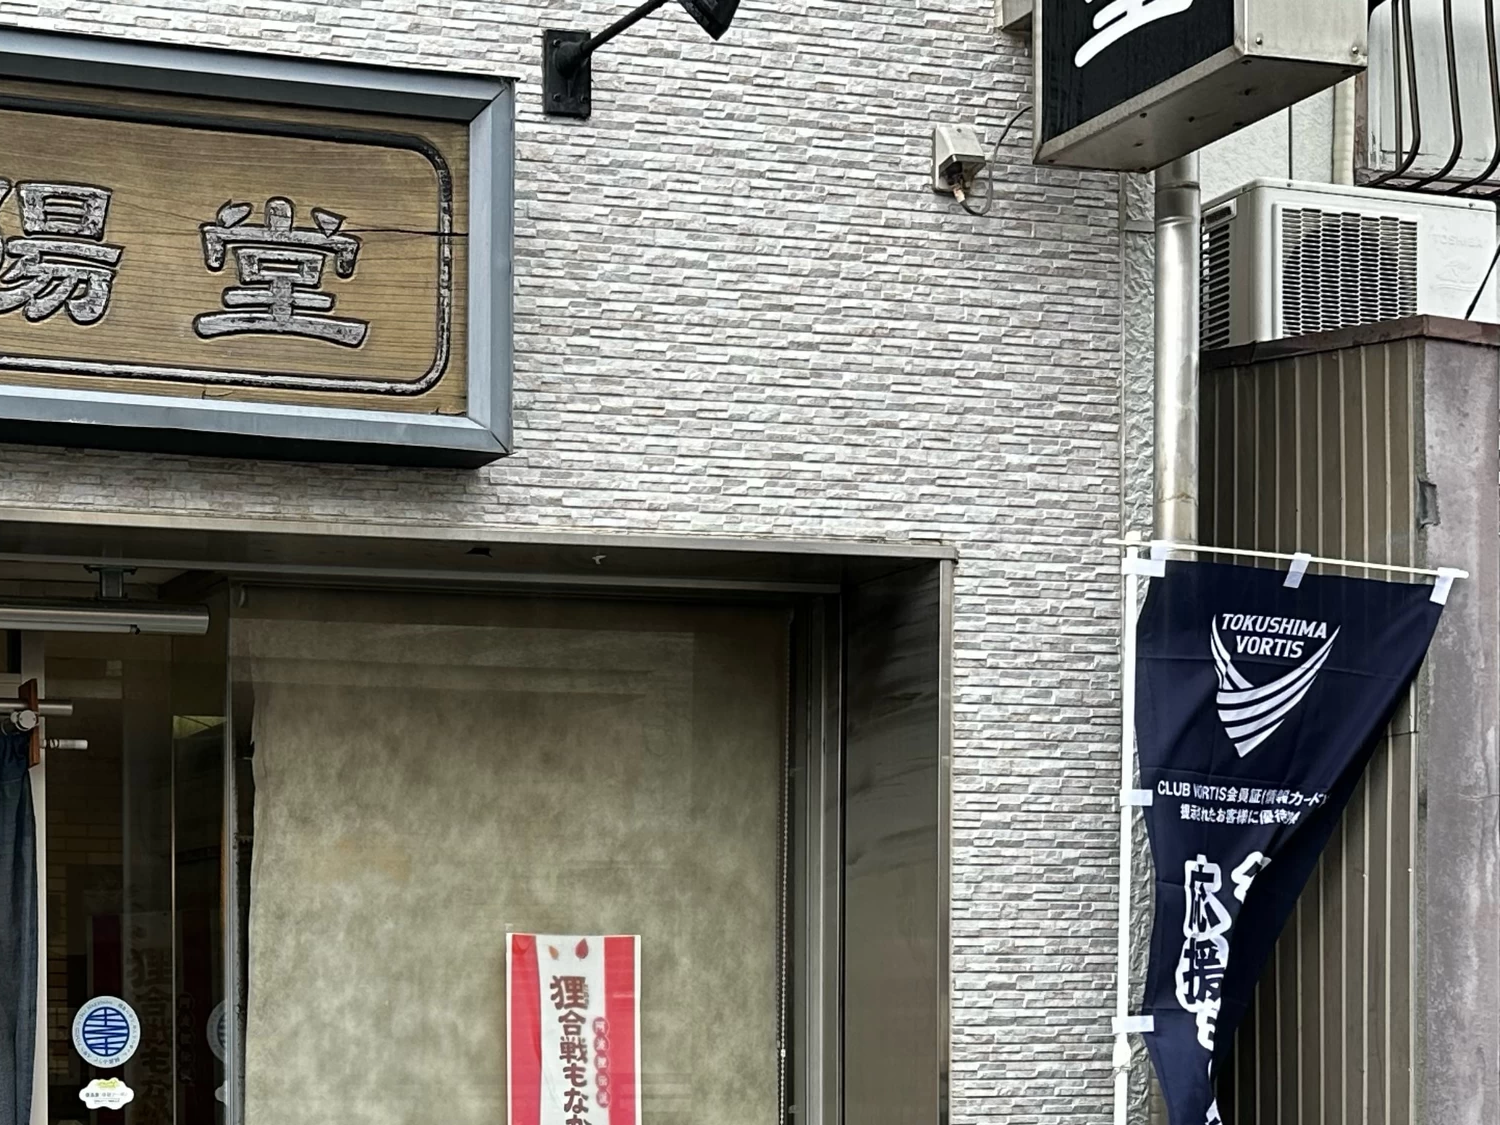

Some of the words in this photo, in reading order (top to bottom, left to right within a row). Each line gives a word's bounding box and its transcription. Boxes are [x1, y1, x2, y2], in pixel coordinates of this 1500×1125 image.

[1221, 613, 1328, 639] TOKUSHIMA
[1236, 635, 1304, 659] VORTIS
[1157, 780, 1191, 797] CLUB
